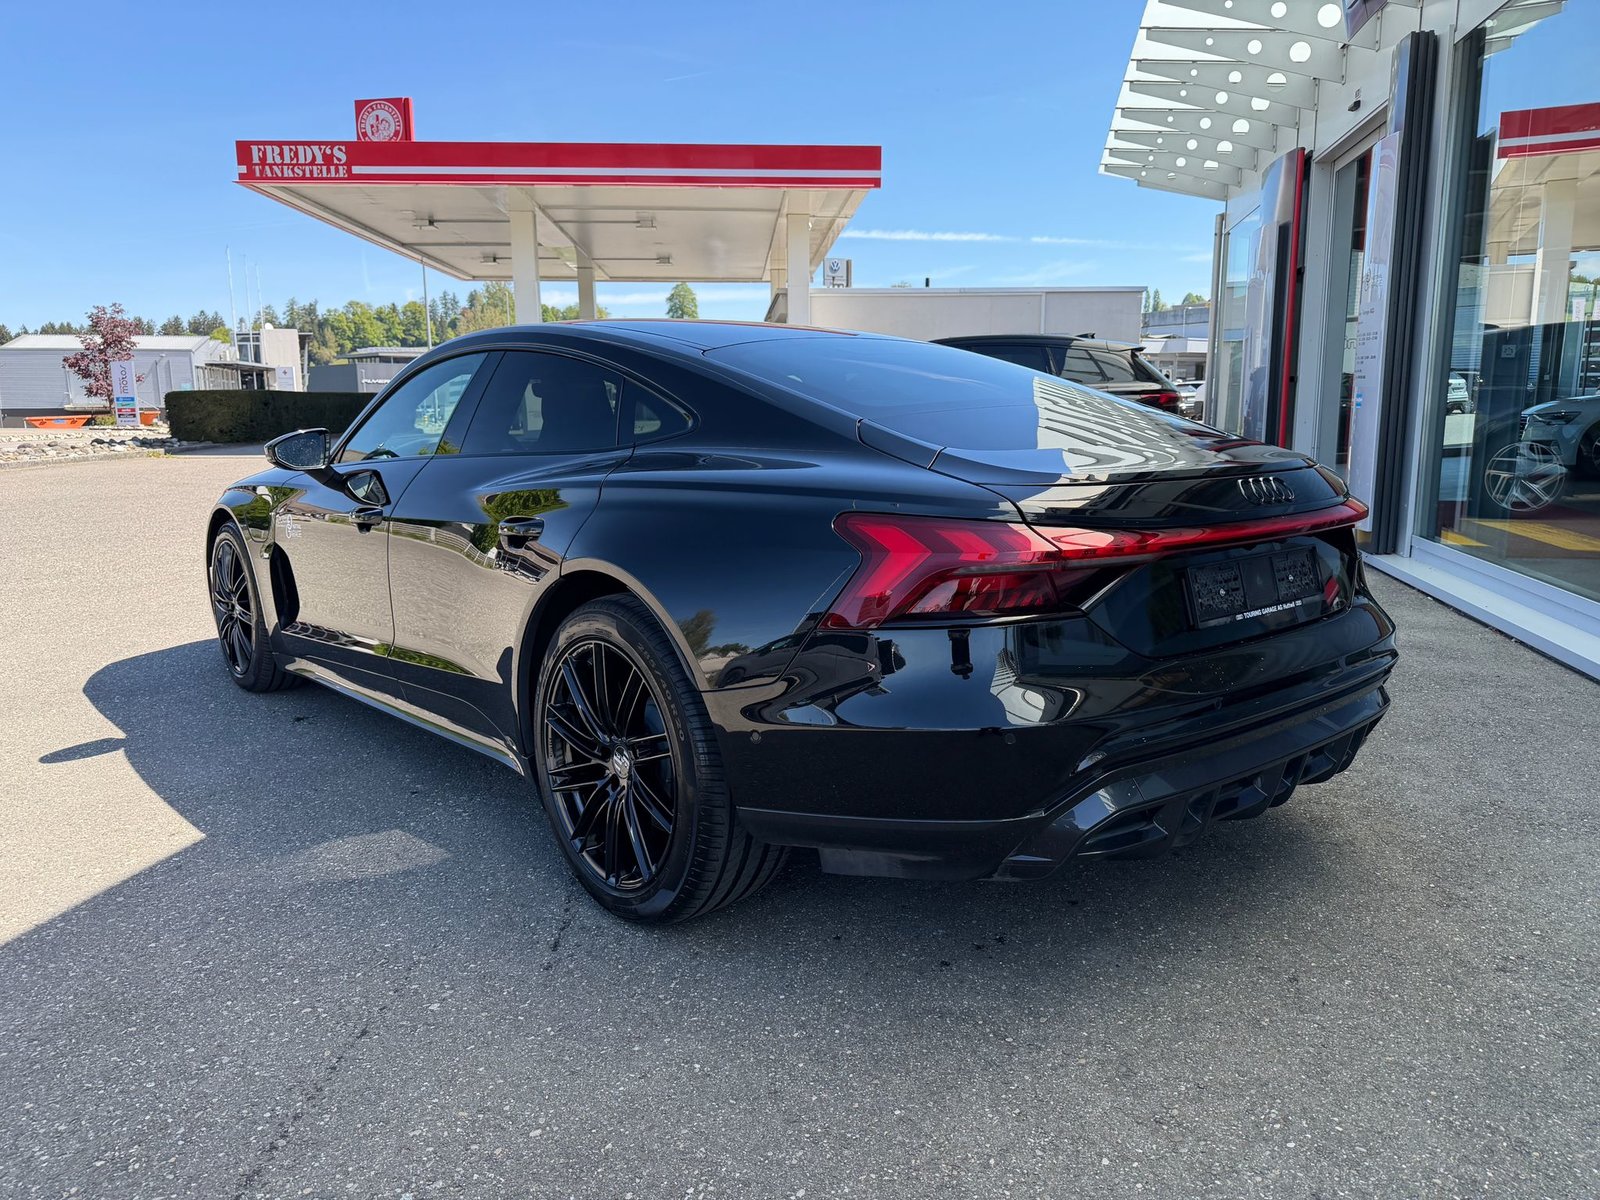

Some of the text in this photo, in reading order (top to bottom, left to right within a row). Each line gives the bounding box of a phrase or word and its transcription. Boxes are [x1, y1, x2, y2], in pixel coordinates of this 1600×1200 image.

[250, 145, 347, 164] FREDY'S
[252, 165, 348, 178] TANKSTELLE
[1261, 605, 1278, 615] GARAGE
